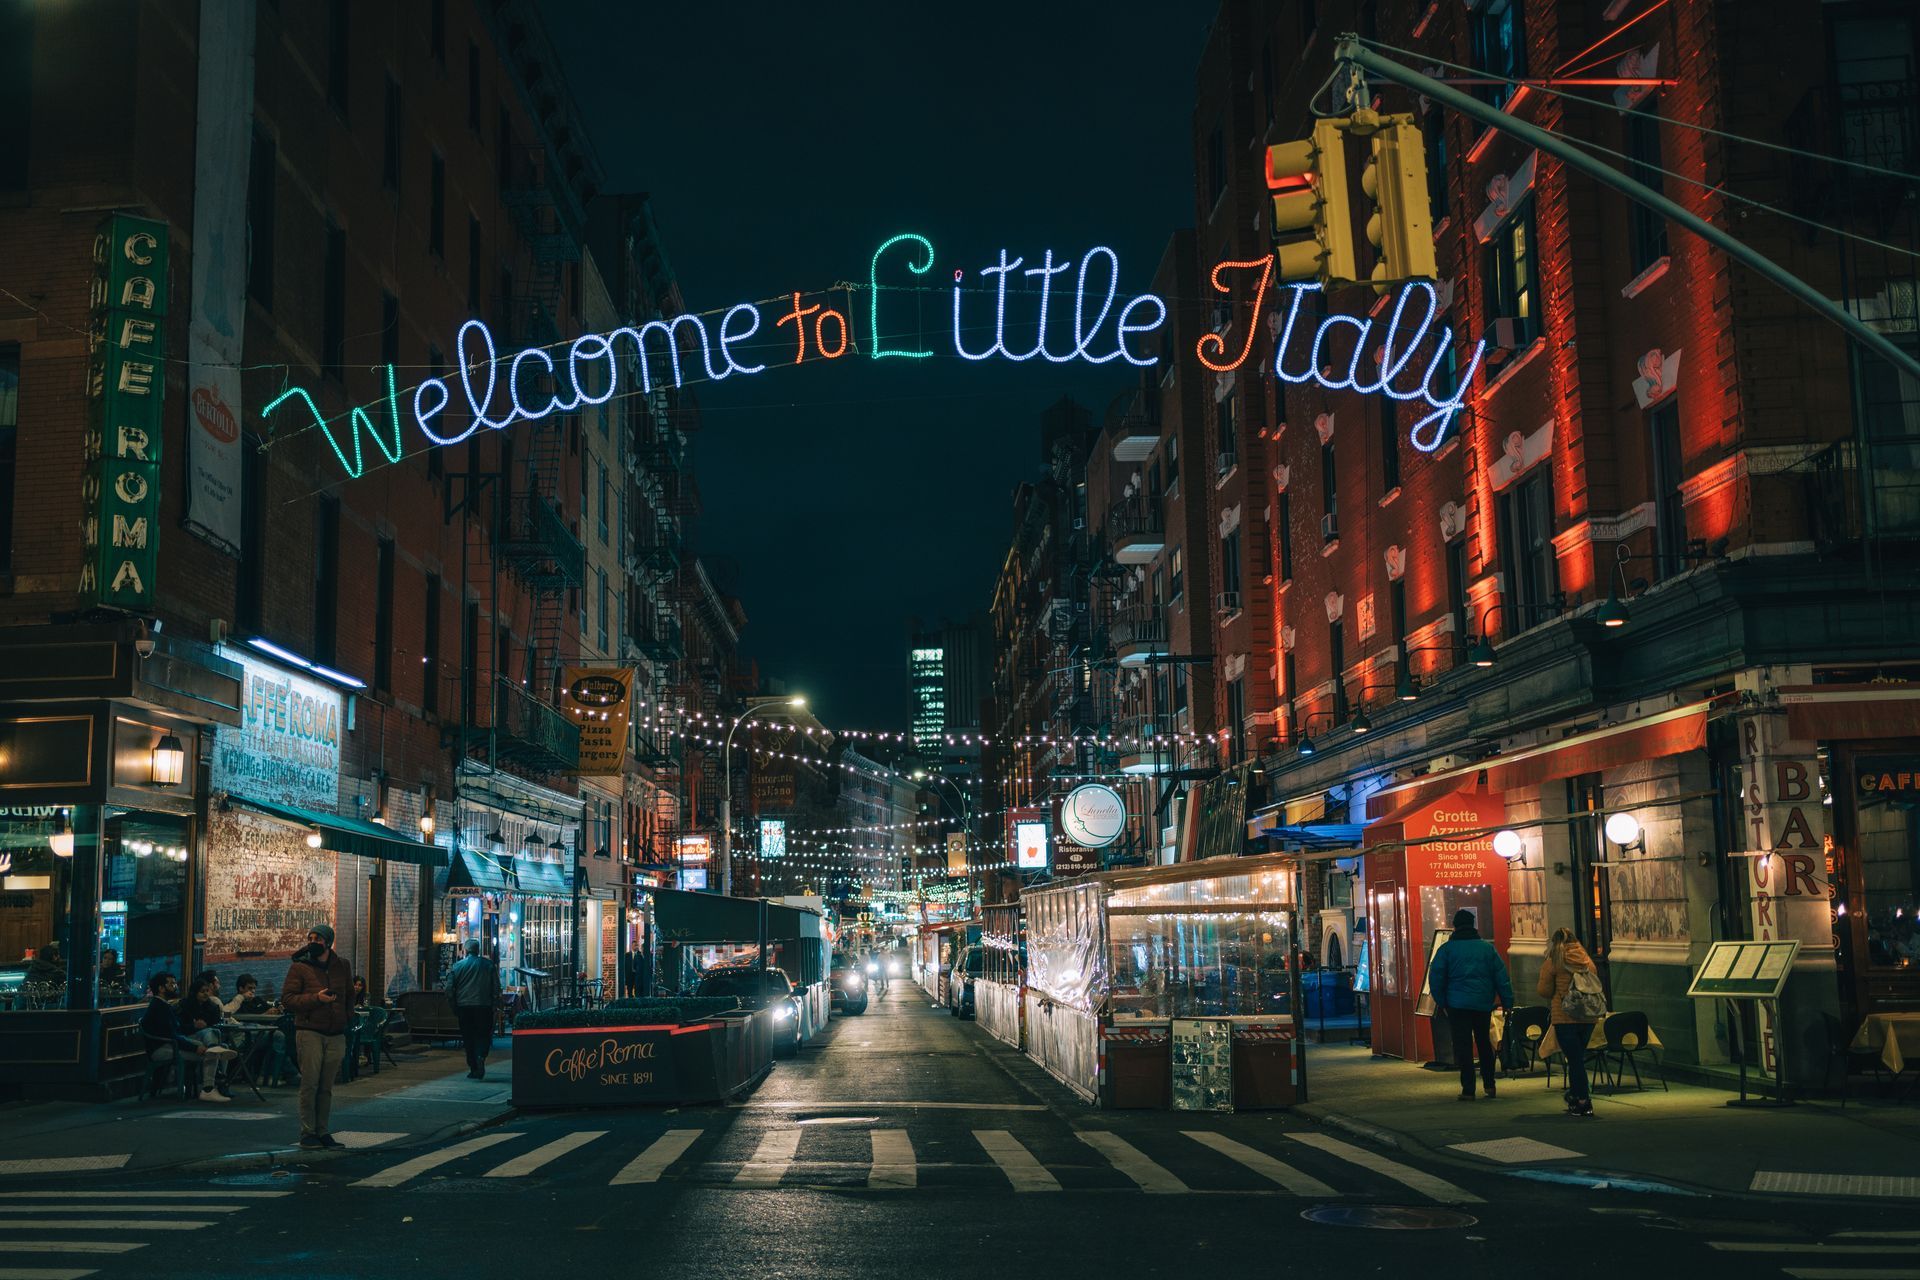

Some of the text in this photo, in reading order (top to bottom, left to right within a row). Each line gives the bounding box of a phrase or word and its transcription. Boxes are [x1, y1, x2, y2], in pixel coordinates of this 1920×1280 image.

[262, 233, 1486, 478] Welcome to Little Italy
[111, 232, 158, 594] CAFE ROMA
[196, 391, 235, 438] BERTOLLI
[581, 680, 619, 692] Mulberry
[289, 689, 338, 749] ROMA
[580, 723, 612, 735] Pizza
[580, 736, 612, 746] Pasta
[1433, 810, 1478, 823] Grotta
[1776, 761, 1821, 896] BAR
[1420, 840, 1493, 852] Ristorante
[1443, 862, 1475, 870] Mulberry
[213, 908, 230, 931] ALL
[545, 1039, 656, 1081] Caffè Roma
[600, 1072, 653, 1086] SINCE 1891
